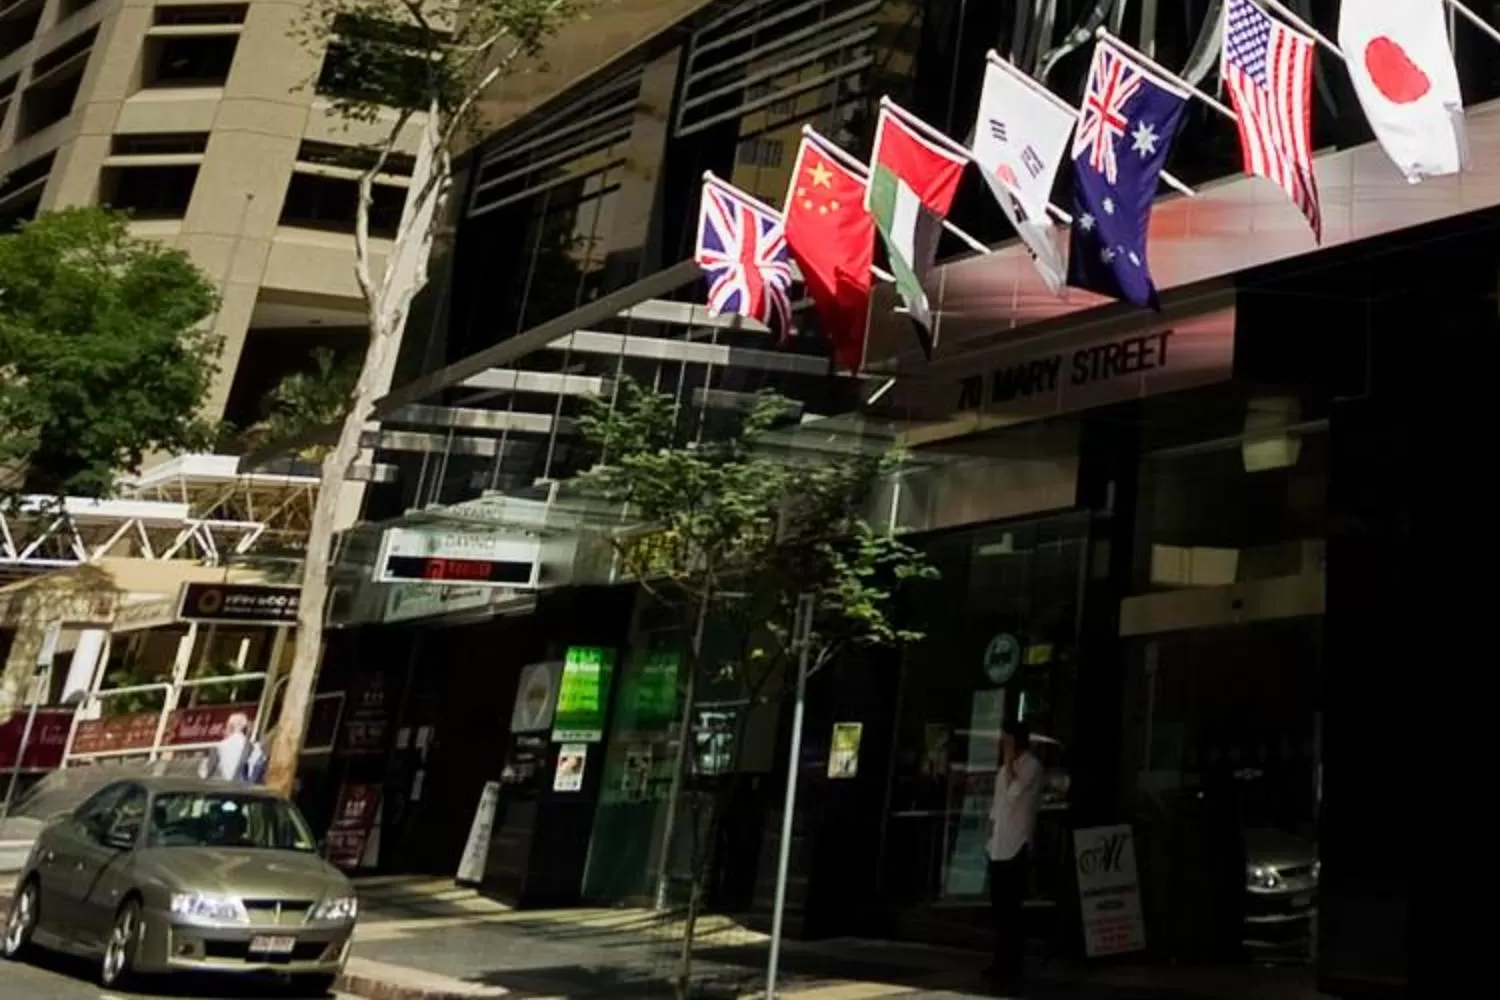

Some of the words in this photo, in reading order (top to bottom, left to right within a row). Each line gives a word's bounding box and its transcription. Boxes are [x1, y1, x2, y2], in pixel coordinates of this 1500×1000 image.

[957, 373, 982, 410] 70
[991, 355, 1063, 402] MARY
[1072, 329, 1173, 386] STREET
